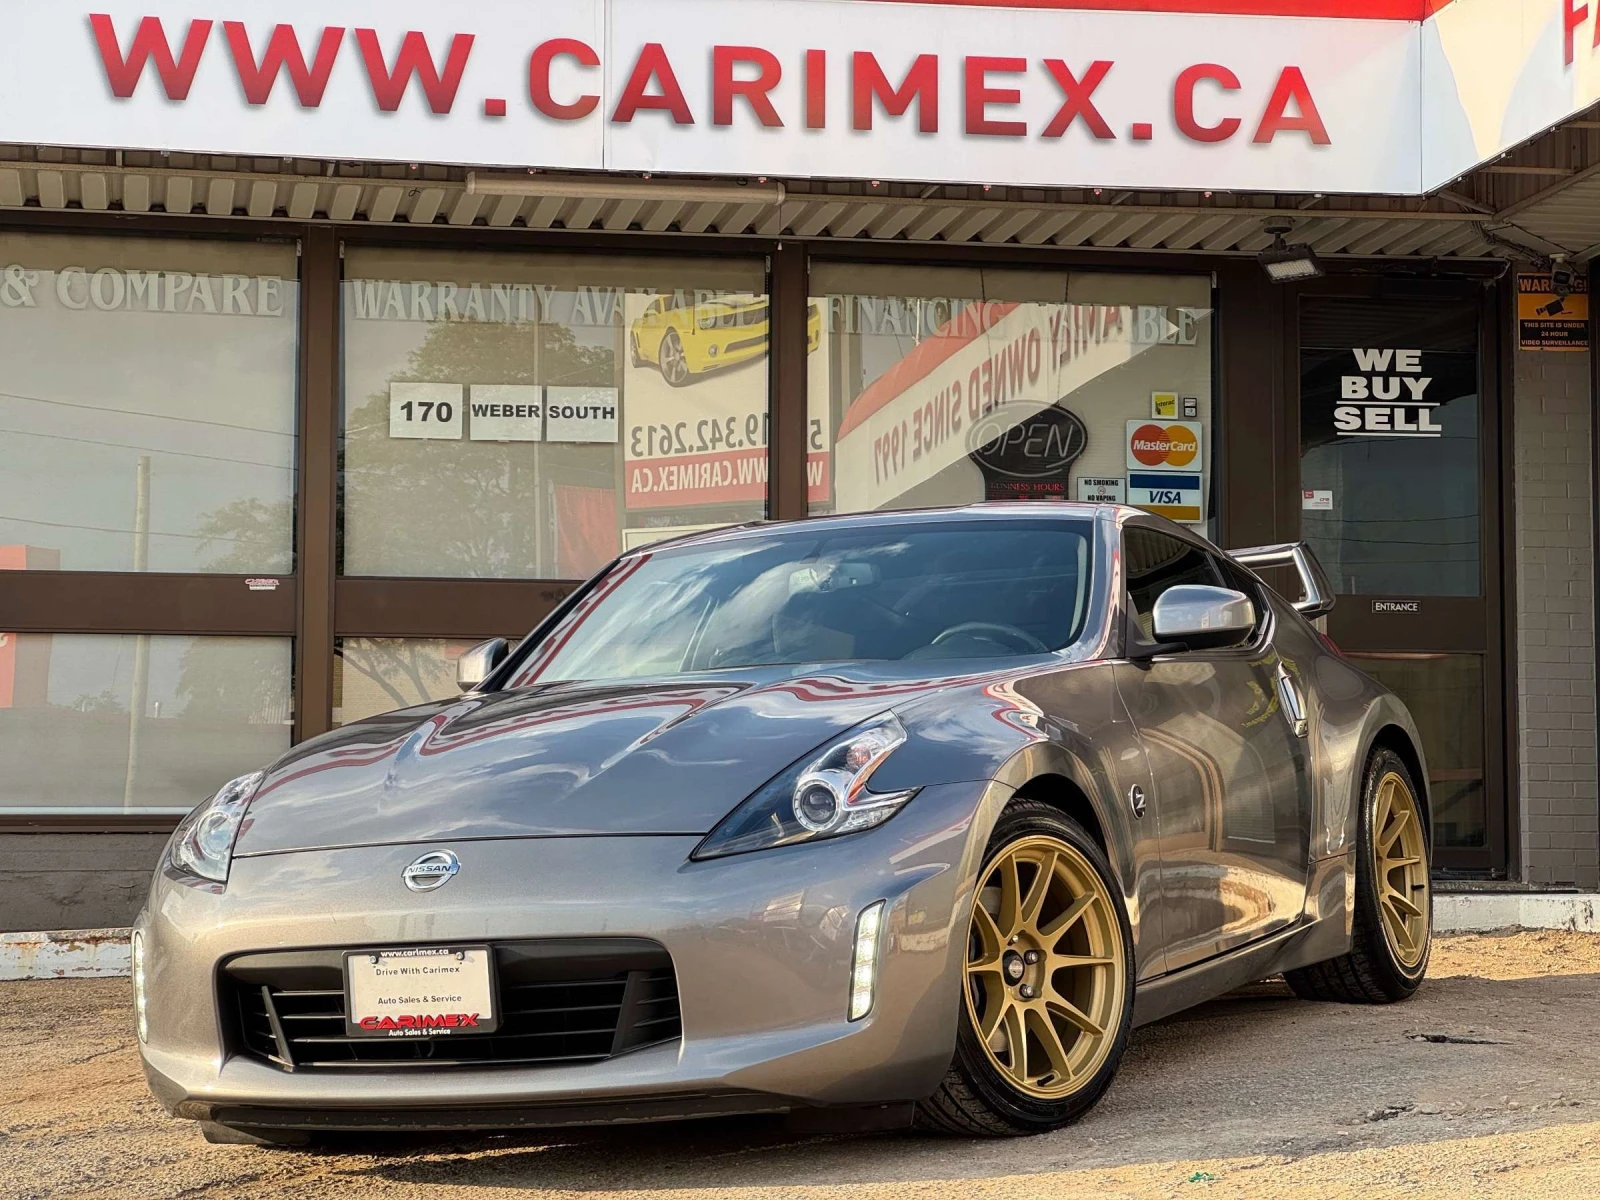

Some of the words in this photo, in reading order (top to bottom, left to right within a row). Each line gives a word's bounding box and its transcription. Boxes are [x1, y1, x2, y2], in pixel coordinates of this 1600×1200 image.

[1564, 0, 1600, 67] F
[89, 13, 1332, 146] WWW.CARIMEX.CA
[1, 264, 38, 308] &
[56, 266, 283, 317] COMPARE
[1519, 278, 1587, 292] WARG!
[350, 278, 557, 325] WARRANTY
[570, 284, 757, 328] AVAABLE
[824, 293, 1007, 338] FINANCING
[1352, 348, 1422, 373] WE
[1341, 375, 1433, 400] BUY
[400, 401, 453, 423] 170
[471, 403, 540, 419] WEBER
[549, 404, 615, 420] SOUTH
[1333, 406, 1442, 431] SELL
[976, 422, 1074, 458] OPEN
[1133, 439, 1197, 452] MasterCard
[1033, 482, 1065, 492] HOURS
[1149, 490, 1182, 504] VISA
[1375, 602, 1418, 611] ENTRANCE
[407, 864, 451, 874] NISSAN
[380, 948, 449, 957] www.carimex.ca
[376, 968, 398, 976] Drive
[400, 967, 420, 975] With
[422, 966, 460, 974] Carimex
[378, 997, 397, 1005] Auto
[398, 996, 420, 1004] Sales
[431, 995, 462, 1003] Service
[360, 1012, 480, 1030] CARIMEX
[404, 1028, 421, 1036] Sales
[428, 1027, 451, 1035] Service
